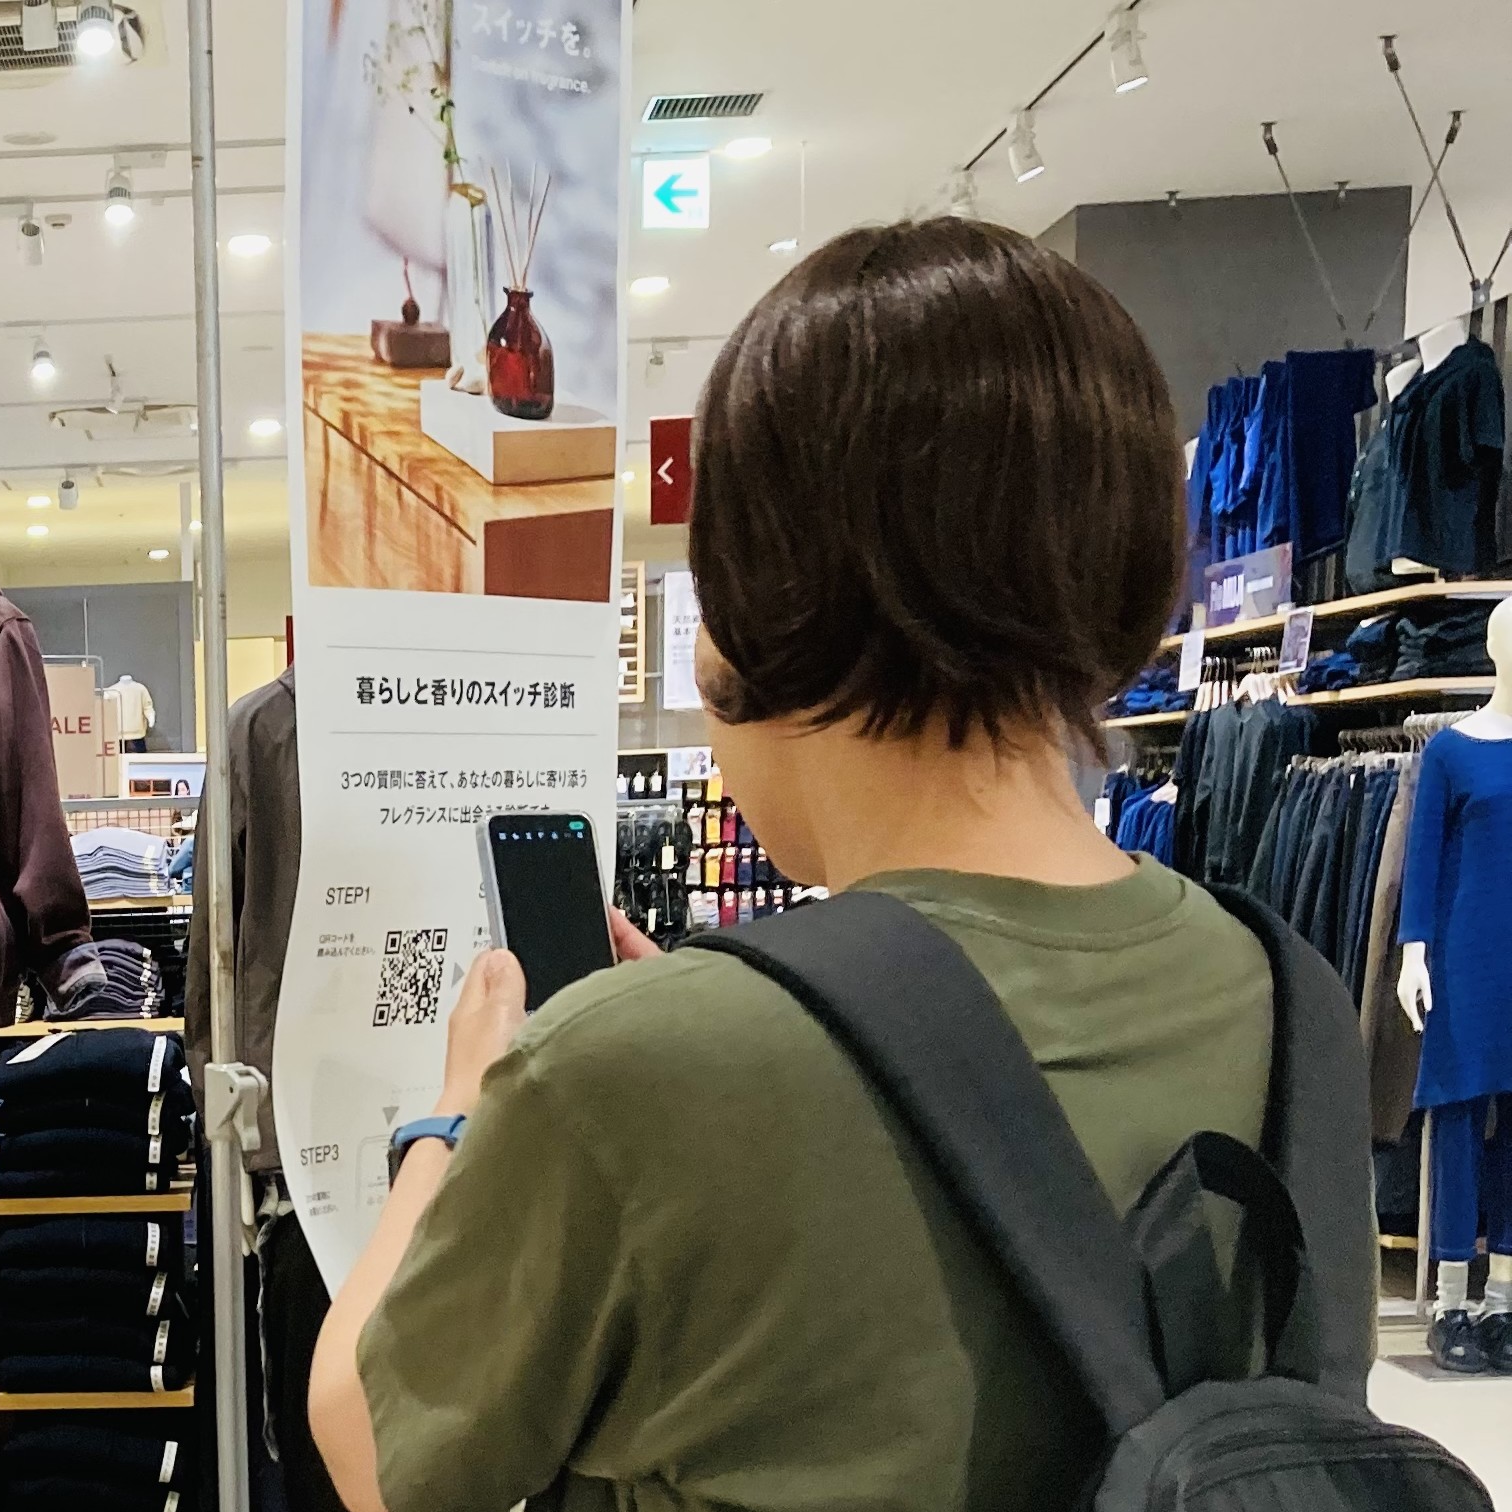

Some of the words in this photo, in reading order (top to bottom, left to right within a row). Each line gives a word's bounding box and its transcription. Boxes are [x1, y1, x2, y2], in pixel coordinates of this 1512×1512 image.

[356, 676, 576, 709] 暮らしと香りのスイッチ診断
[51, 715, 92, 735] ALE
[341, 769, 588, 790] 3つの質問に答えて、あなたの暮らしに寄り添う
[325, 886, 371, 906] STEP1
[300, 1143, 340, 1167] STEP3
